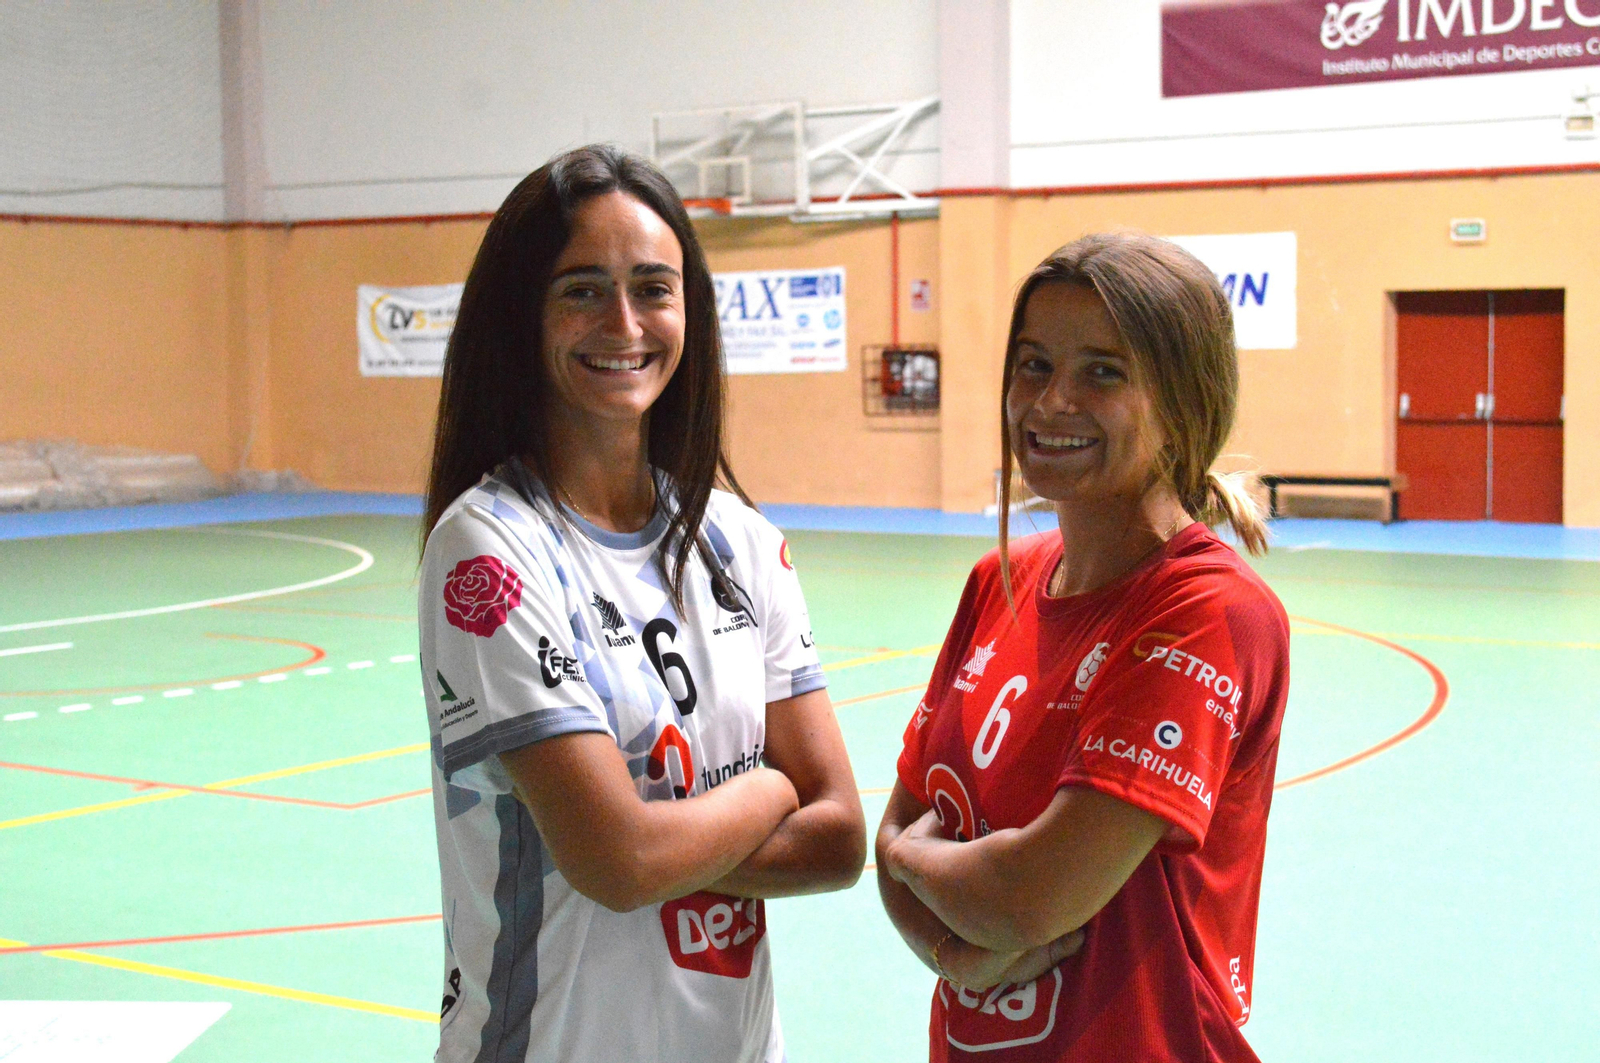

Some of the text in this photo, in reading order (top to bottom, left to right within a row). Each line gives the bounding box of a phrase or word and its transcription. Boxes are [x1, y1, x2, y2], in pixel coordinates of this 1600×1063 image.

[1322, 36, 1600, 76] Instituto Municipal de Deportes C
[642, 618, 698, 717] 6
[444, 696, 476, 717] Andalucía
[972, 674, 1028, 770] 6
[1083, 735, 1105, 753] LA
[1108, 738, 1212, 811] CARIHUELA
